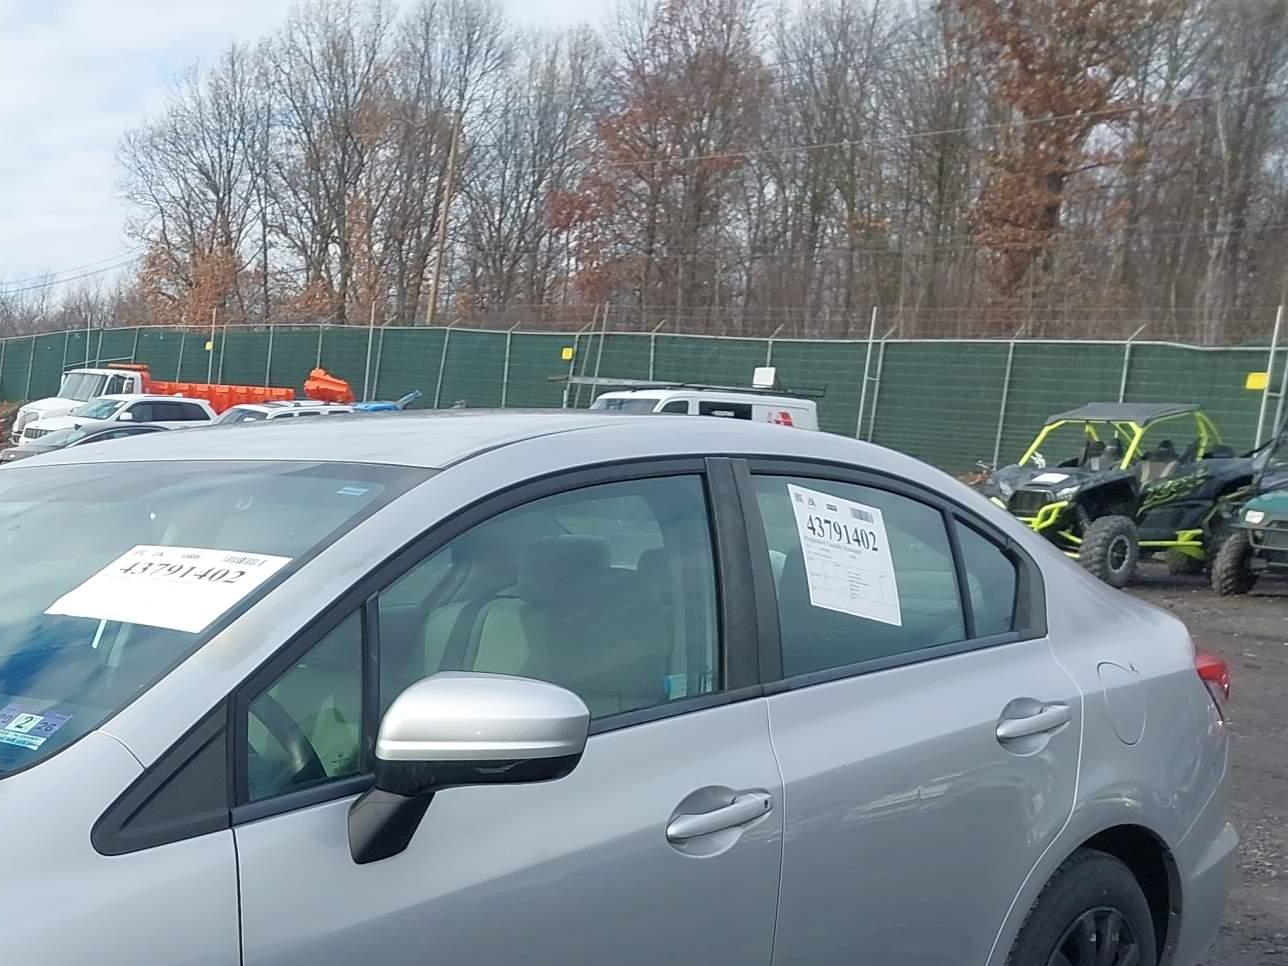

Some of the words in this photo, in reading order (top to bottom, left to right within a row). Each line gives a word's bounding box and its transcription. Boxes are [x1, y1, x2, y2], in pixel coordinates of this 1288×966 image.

[807, 514, 878, 551] 43791402
[119, 561, 246, 584] 43791402
[15, 716, 34, 729] 2
[36, 721, 57, 732] 26
